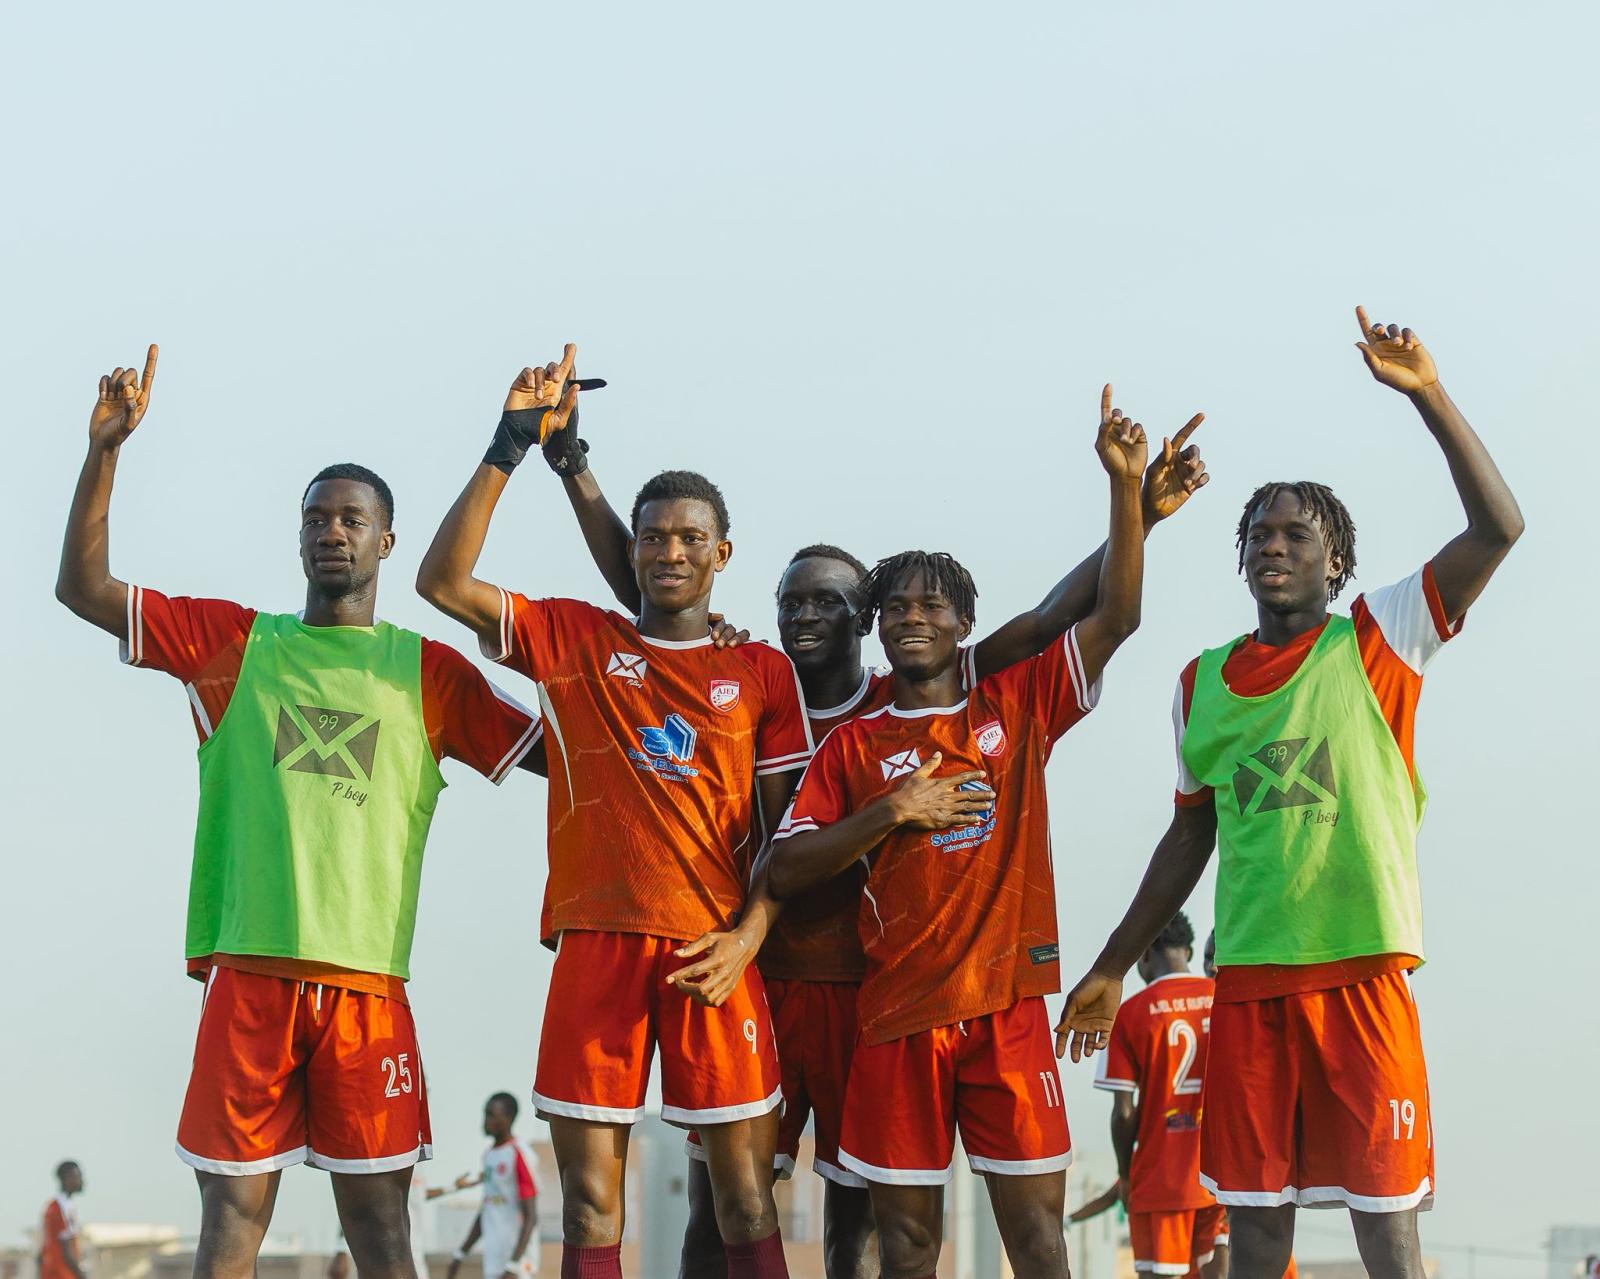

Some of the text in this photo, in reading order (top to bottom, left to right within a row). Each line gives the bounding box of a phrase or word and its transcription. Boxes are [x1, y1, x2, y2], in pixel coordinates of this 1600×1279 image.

[318, 714, 339, 731] 99
[1267, 745, 1288, 764] 99
[331, 781, 368, 807] P.boy
[930, 817, 997, 847] SoluEtud
[1302, 808, 1340, 828] P.boy
[743, 1018, 757, 1055] 9
[1167, 1017, 1211, 1096] 2
[381, 1053, 413, 1098] 25
[1039, 1071, 1060, 1108] 11
[1389, 1098, 1416, 1141] 19
